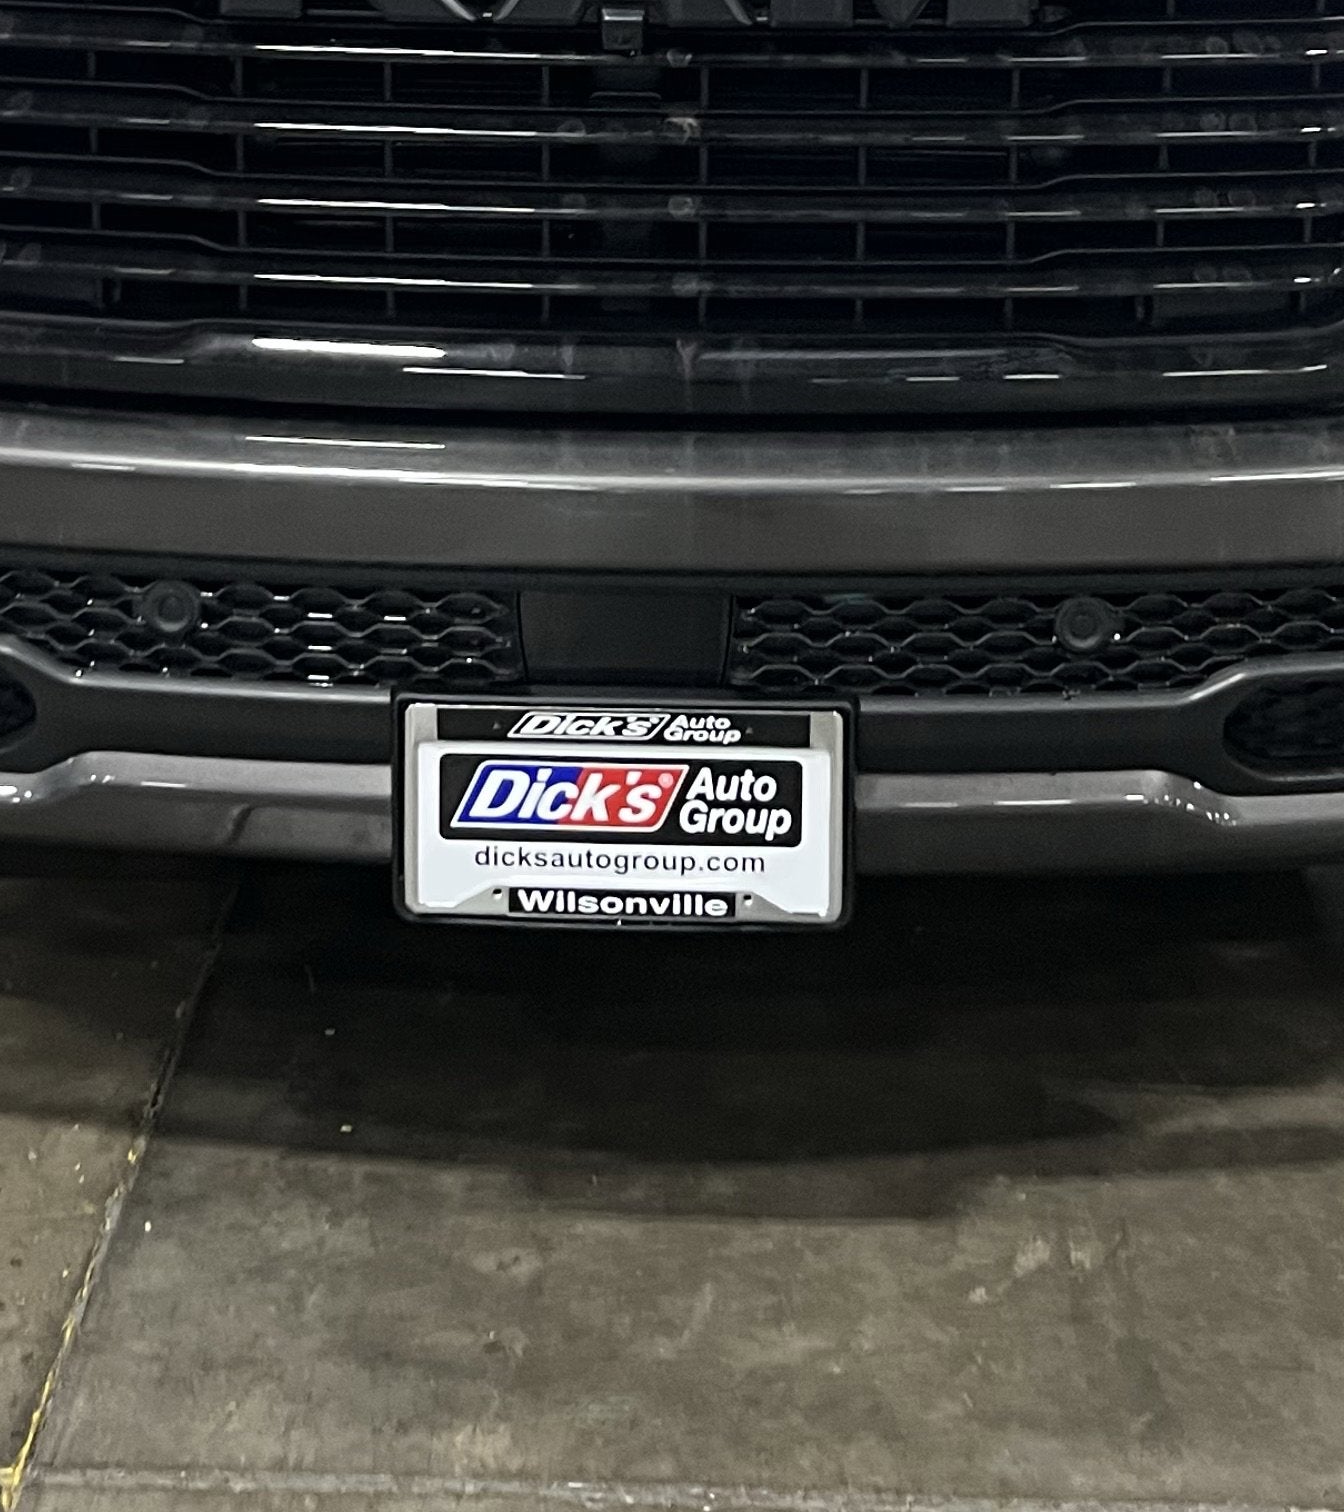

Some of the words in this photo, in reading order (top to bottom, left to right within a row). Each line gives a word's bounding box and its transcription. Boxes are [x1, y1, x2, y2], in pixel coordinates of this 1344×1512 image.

[664, 727, 742, 745] Group
[669, 715, 732, 730] Auto
[469, 768, 663, 823] Dick's
[687, 767, 777, 802] Auto
[679, 800, 792, 841] Group
[475, 846, 765, 876] dicksautogroup.com
[518, 888, 729, 917] Wilsonville
